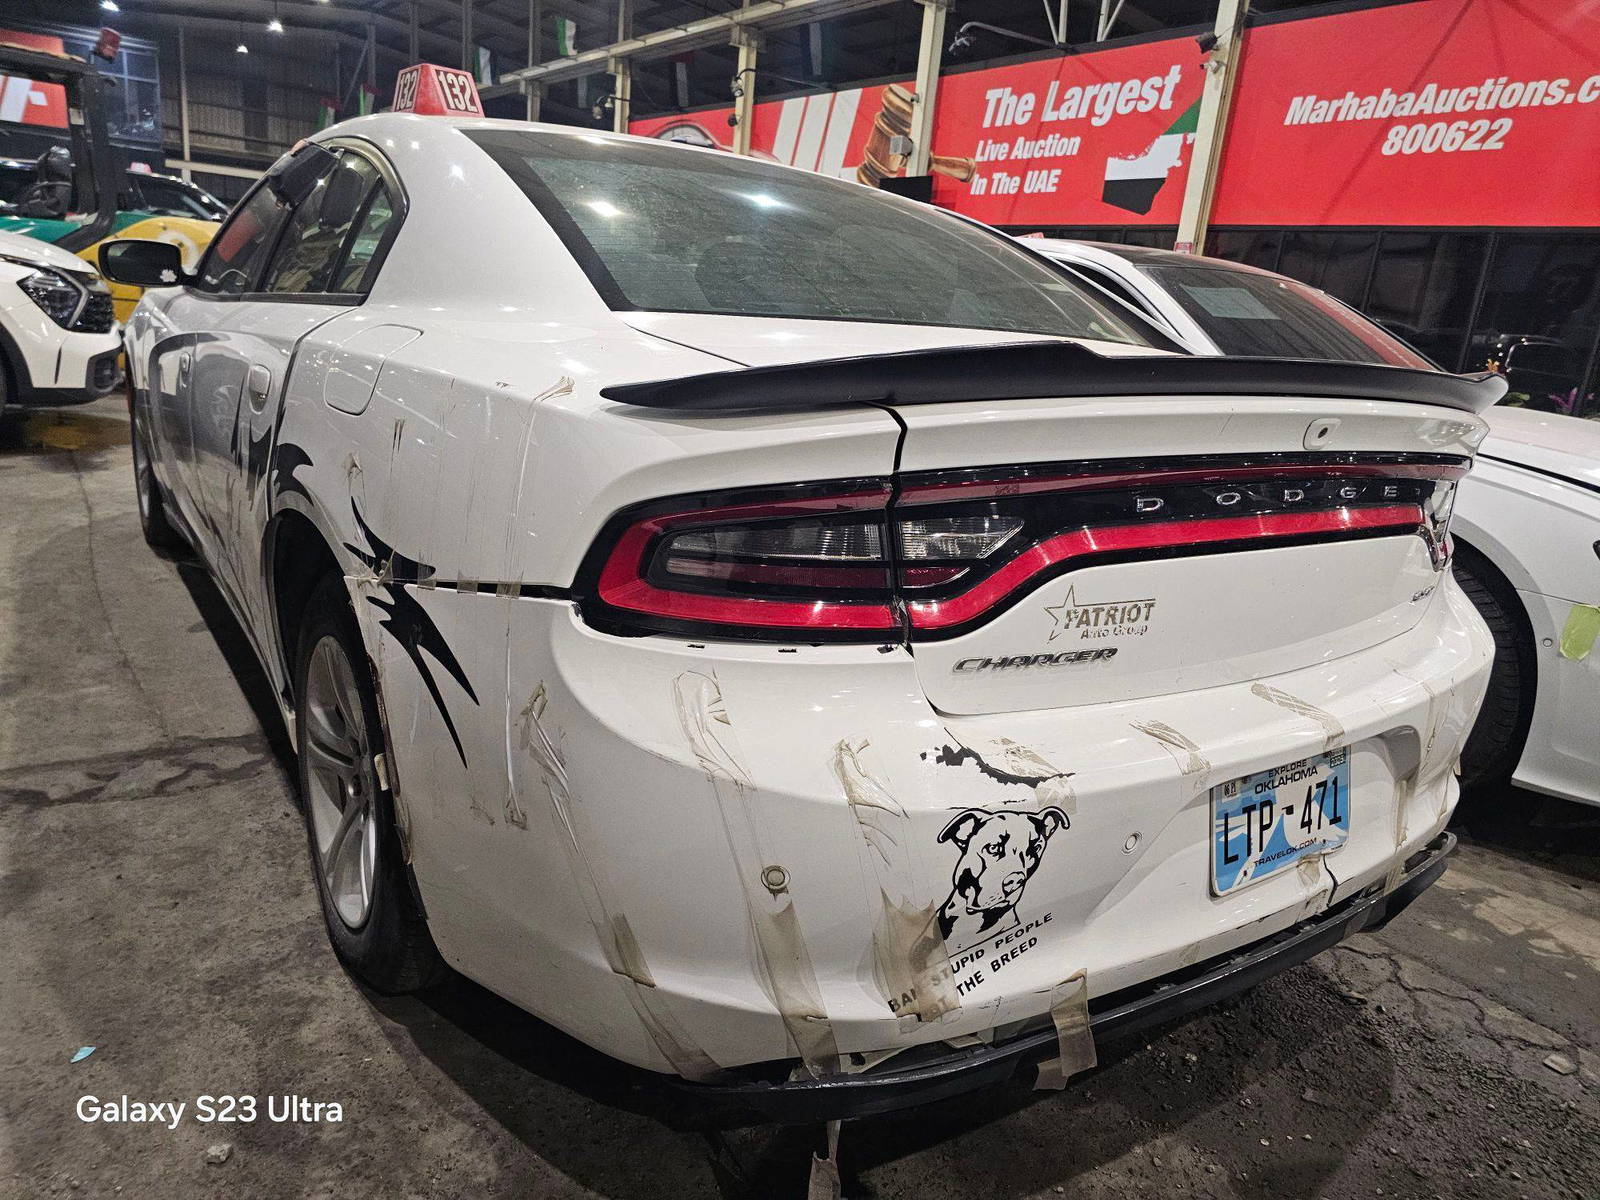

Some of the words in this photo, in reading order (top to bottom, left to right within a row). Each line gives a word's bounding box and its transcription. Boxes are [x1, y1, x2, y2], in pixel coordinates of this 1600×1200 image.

[397, 71, 417, 110] 132
[438, 71, 477, 112] 132
[982, 87, 1036, 128] The
[1041, 64, 1182, 127] Largest
[975, 139, 1009, 162] Live
[1010, 134, 1081, 160] Auction
[1381, 118, 1513, 156] 800622
[969, 173, 988, 195] In
[990, 172, 1020, 195] The
[1023, 169, 1062, 193] UAE
[1136, 485, 1398, 513] DODGE
[1063, 602, 1156, 630] PATRIOT
[953, 647, 1118, 673] CHARGER
[1254, 765, 1319, 795] OKLAHOMA
[1268, 759, 1308, 779] EXPLORE
[1300, 775, 1342, 835] 471
[1254, 837, 1318, 868] TRAVELOK.COM
[994, 912, 1054, 950] PEOPLE
[956, 970, 986, 998] THE
[989, 936, 1039, 974] BREED
